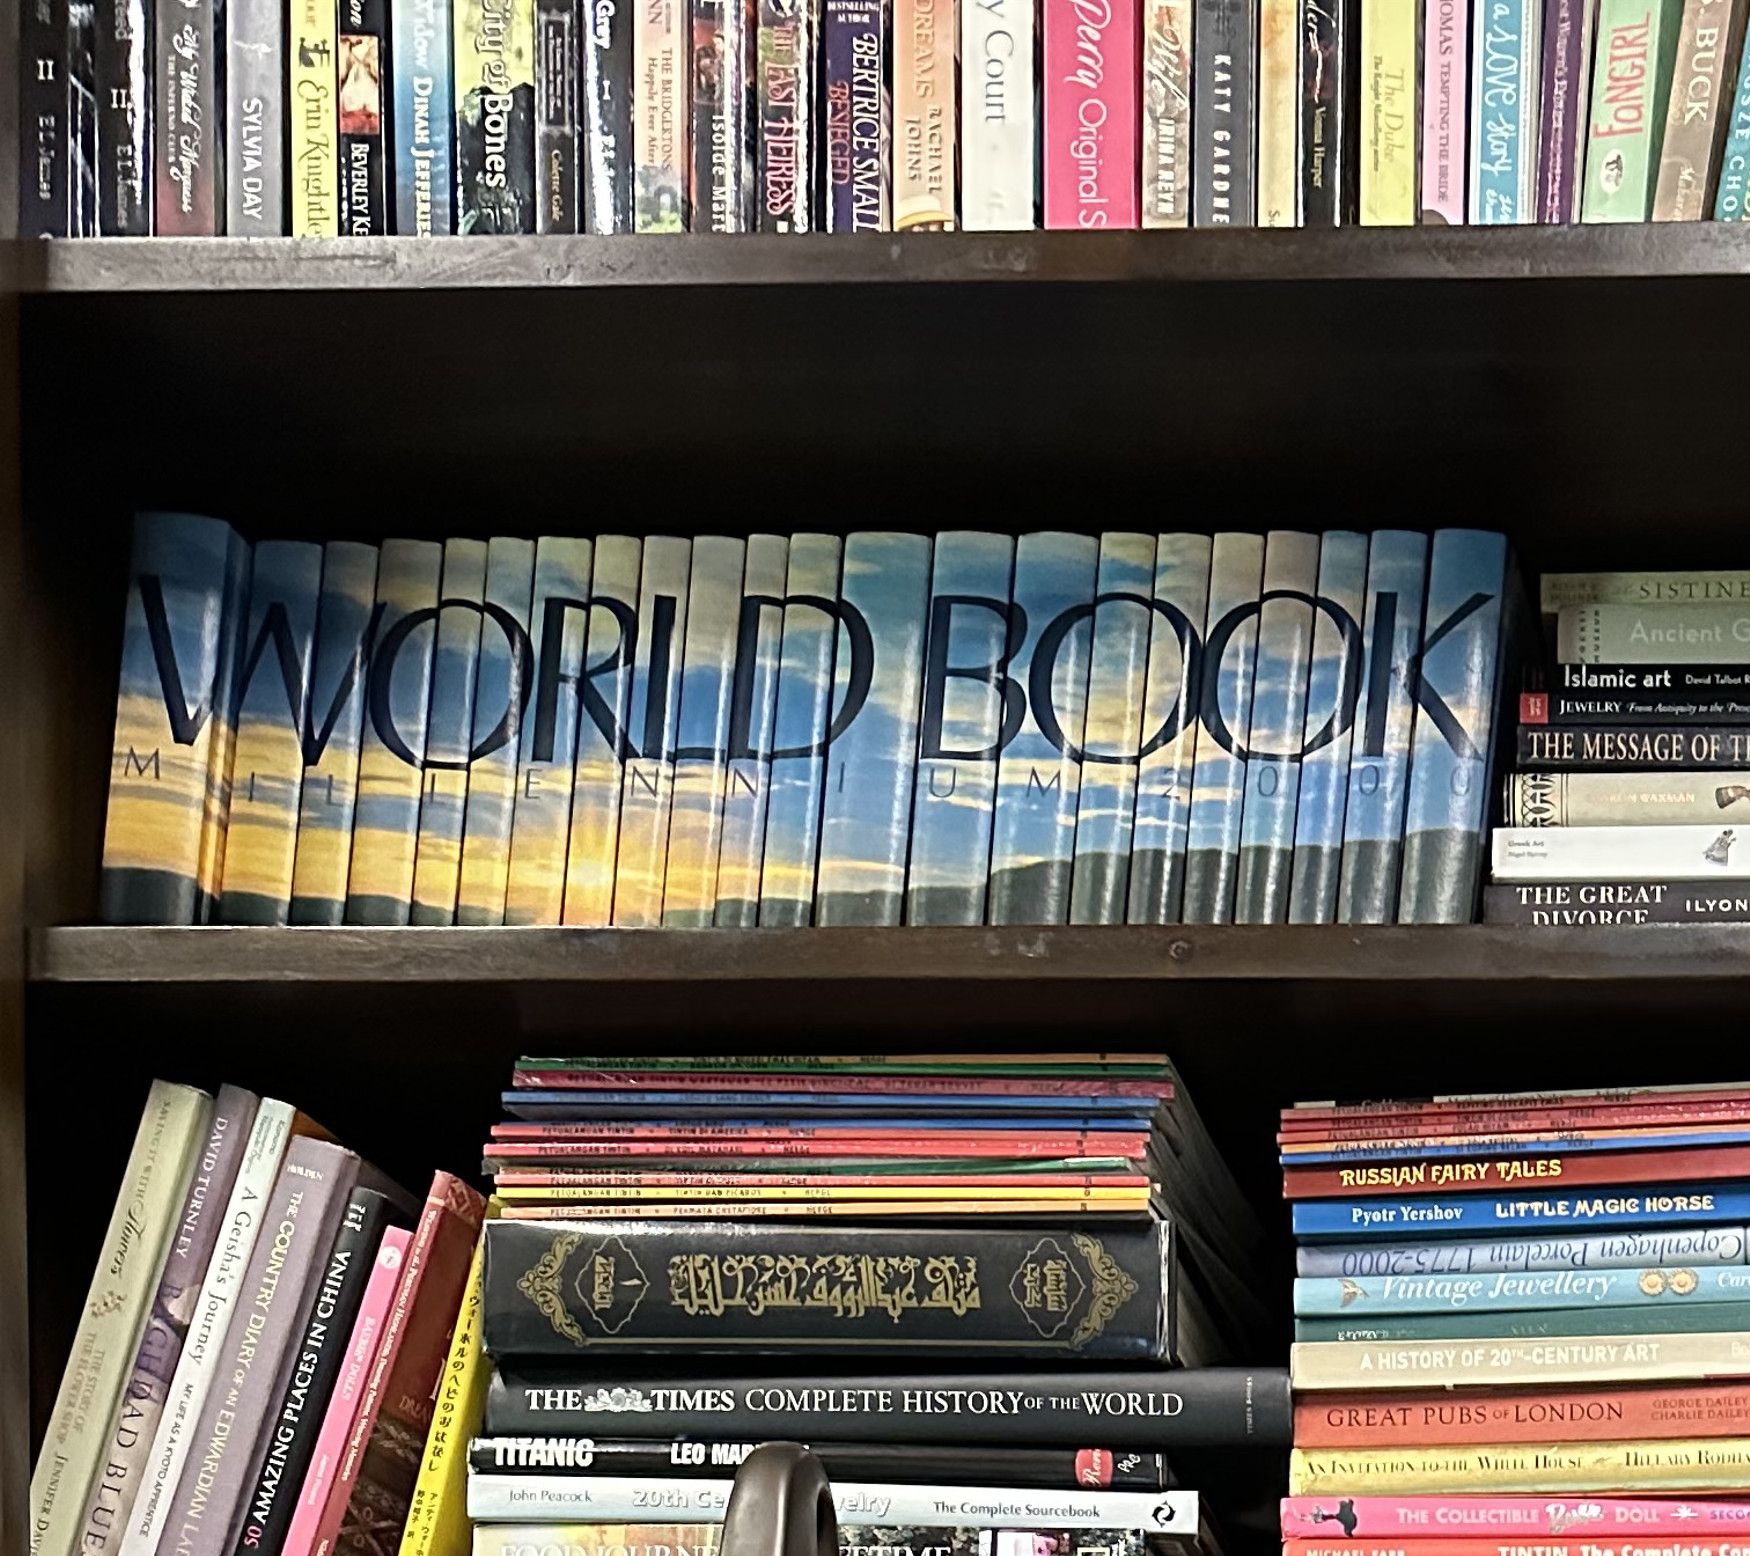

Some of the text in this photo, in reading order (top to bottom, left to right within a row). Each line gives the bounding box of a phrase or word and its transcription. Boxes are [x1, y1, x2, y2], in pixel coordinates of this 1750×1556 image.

[241, 97, 263, 220] SYLVIA DAY
[1639, 579, 1750, 600] SISTINE
[136, 574, 1496, 769] WORLD BOOK
[1564, 665, 1671, 688] Islamic art
[1560, 700, 1621, 715] JEWELRY
[1528, 733, 1573, 758] THE
[1582, 734, 1683, 761] MESSAGE
[1692, 734, 1720, 761] OF
[1517, 885, 1667, 904] THE GREAT
[1686, 899, 1748, 912] ILYON
[1341, 1159, 1561, 1186] RUSSIAN FAIRY TALES
[1496, 1195, 1714, 1218] LITTLE MAGIC HORSE
[1381, 1272, 1615, 1302] Vintage Jewellery
[244, 1251, 350, 1549] 50 AMAZING PLACES IN CHINA
[526, 1389, 1183, 1416] THE TIMES COMPLETE HISTORY OF THE WORLD
[1327, 1402, 1623, 1428] GREAT PUBS OF LONDON
[510, 1488, 592, 1503] John Peacock
[934, 1501, 1099, 1518] The Complete Sourcebook
